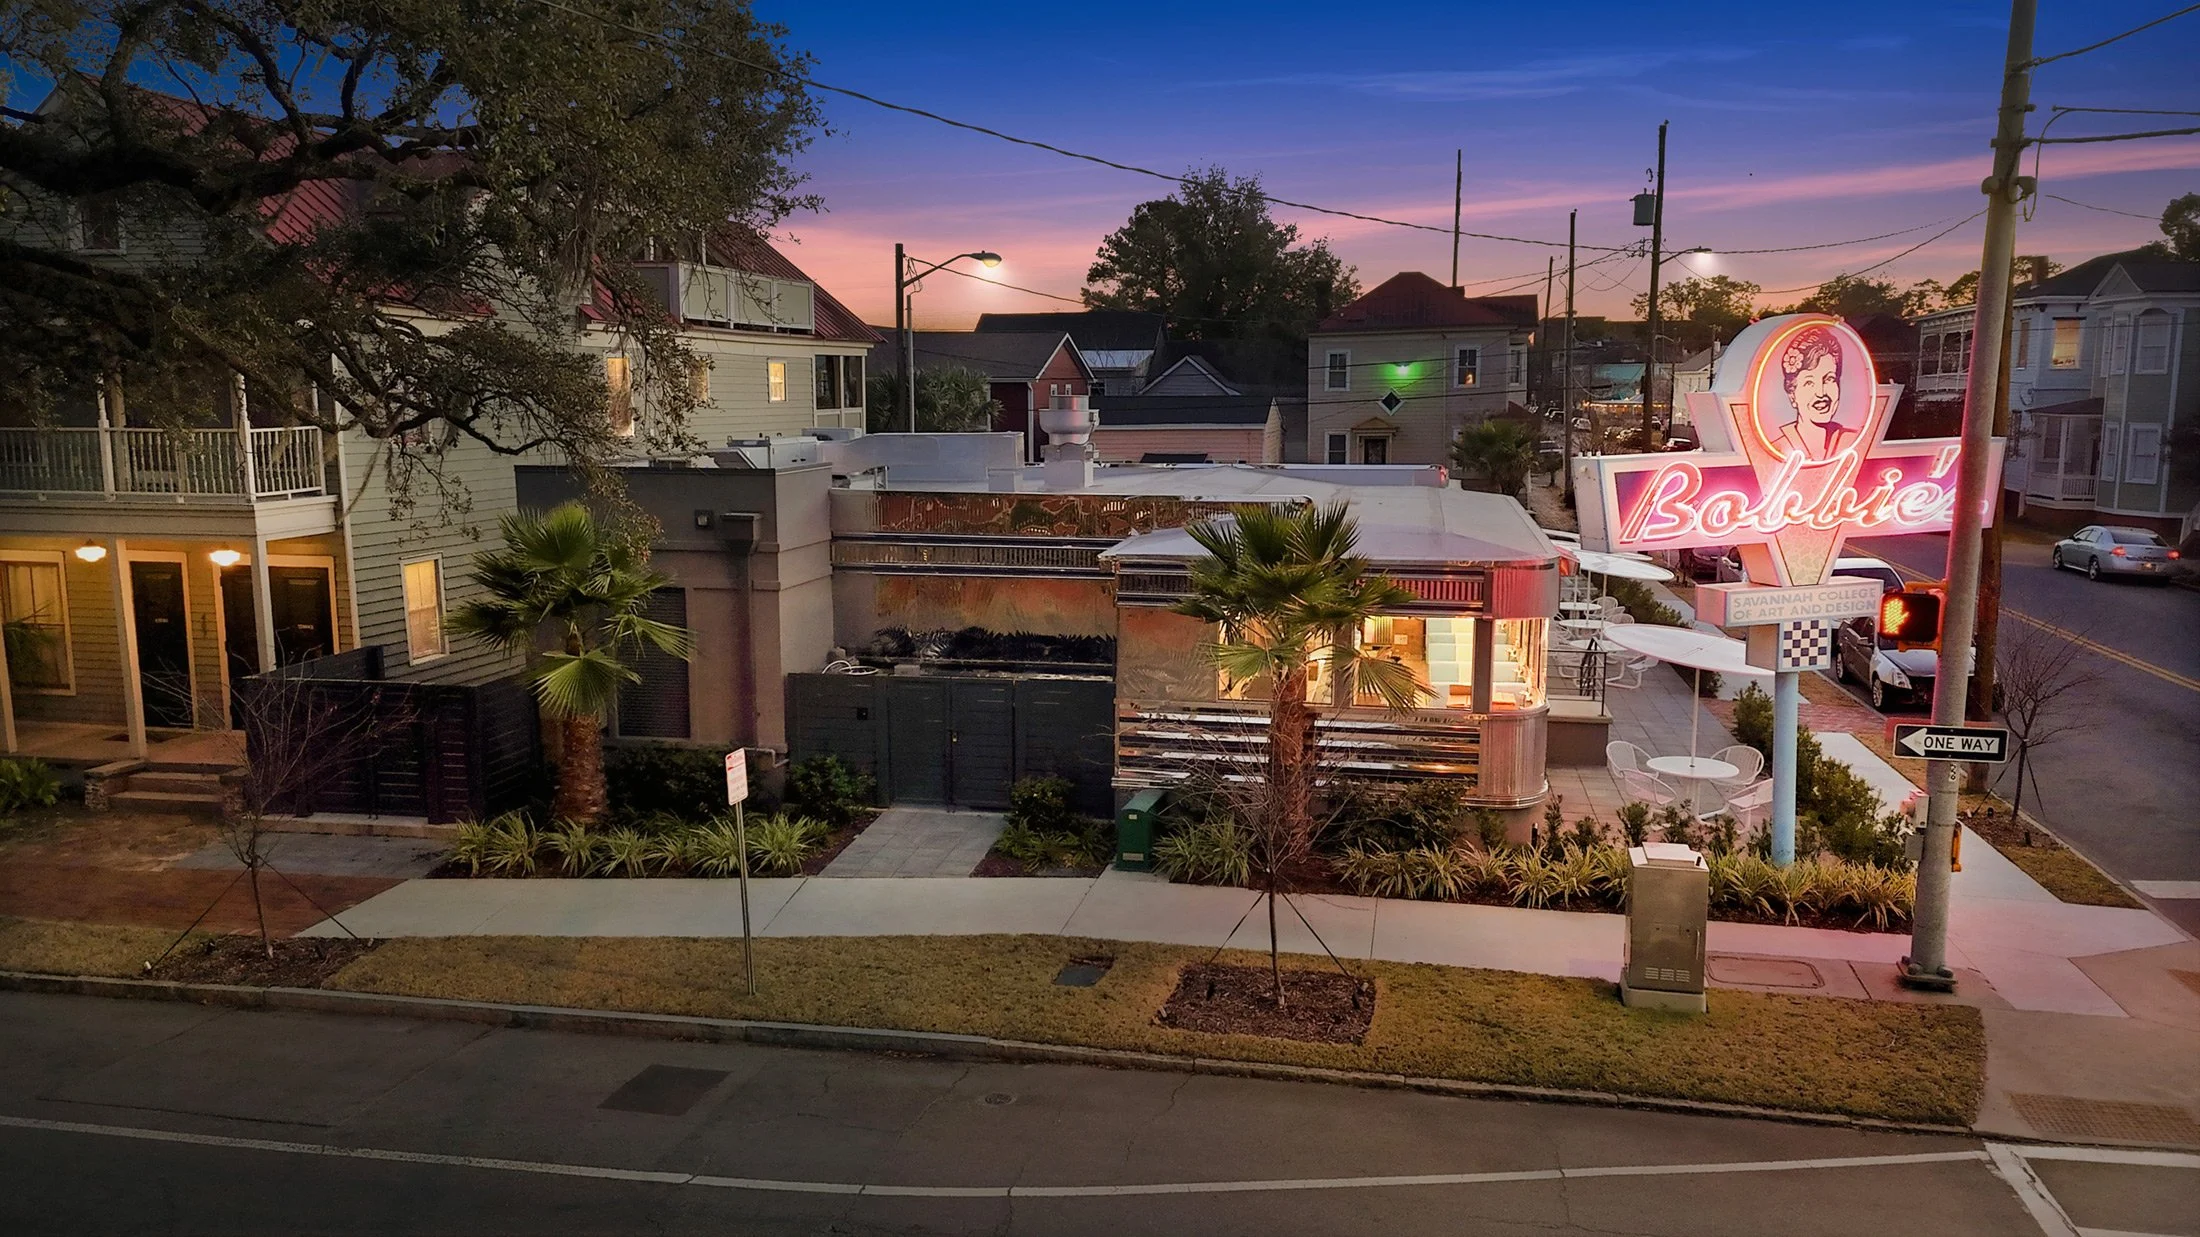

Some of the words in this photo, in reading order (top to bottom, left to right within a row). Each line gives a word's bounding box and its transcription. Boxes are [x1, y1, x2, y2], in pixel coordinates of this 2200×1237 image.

[1733, 592, 1813, 609] SAVANNAH
[1818, 588, 1876, 602] COLLEGE
[1733, 610, 1752, 621] OF
[1758, 606, 1785, 618] ART
[1790, 604, 1822, 616] AND
[1825, 600, 1876, 613] DESIGN
[1924, 736, 1955, 750] ONE
[1961, 737, 1995, 751] WAY
